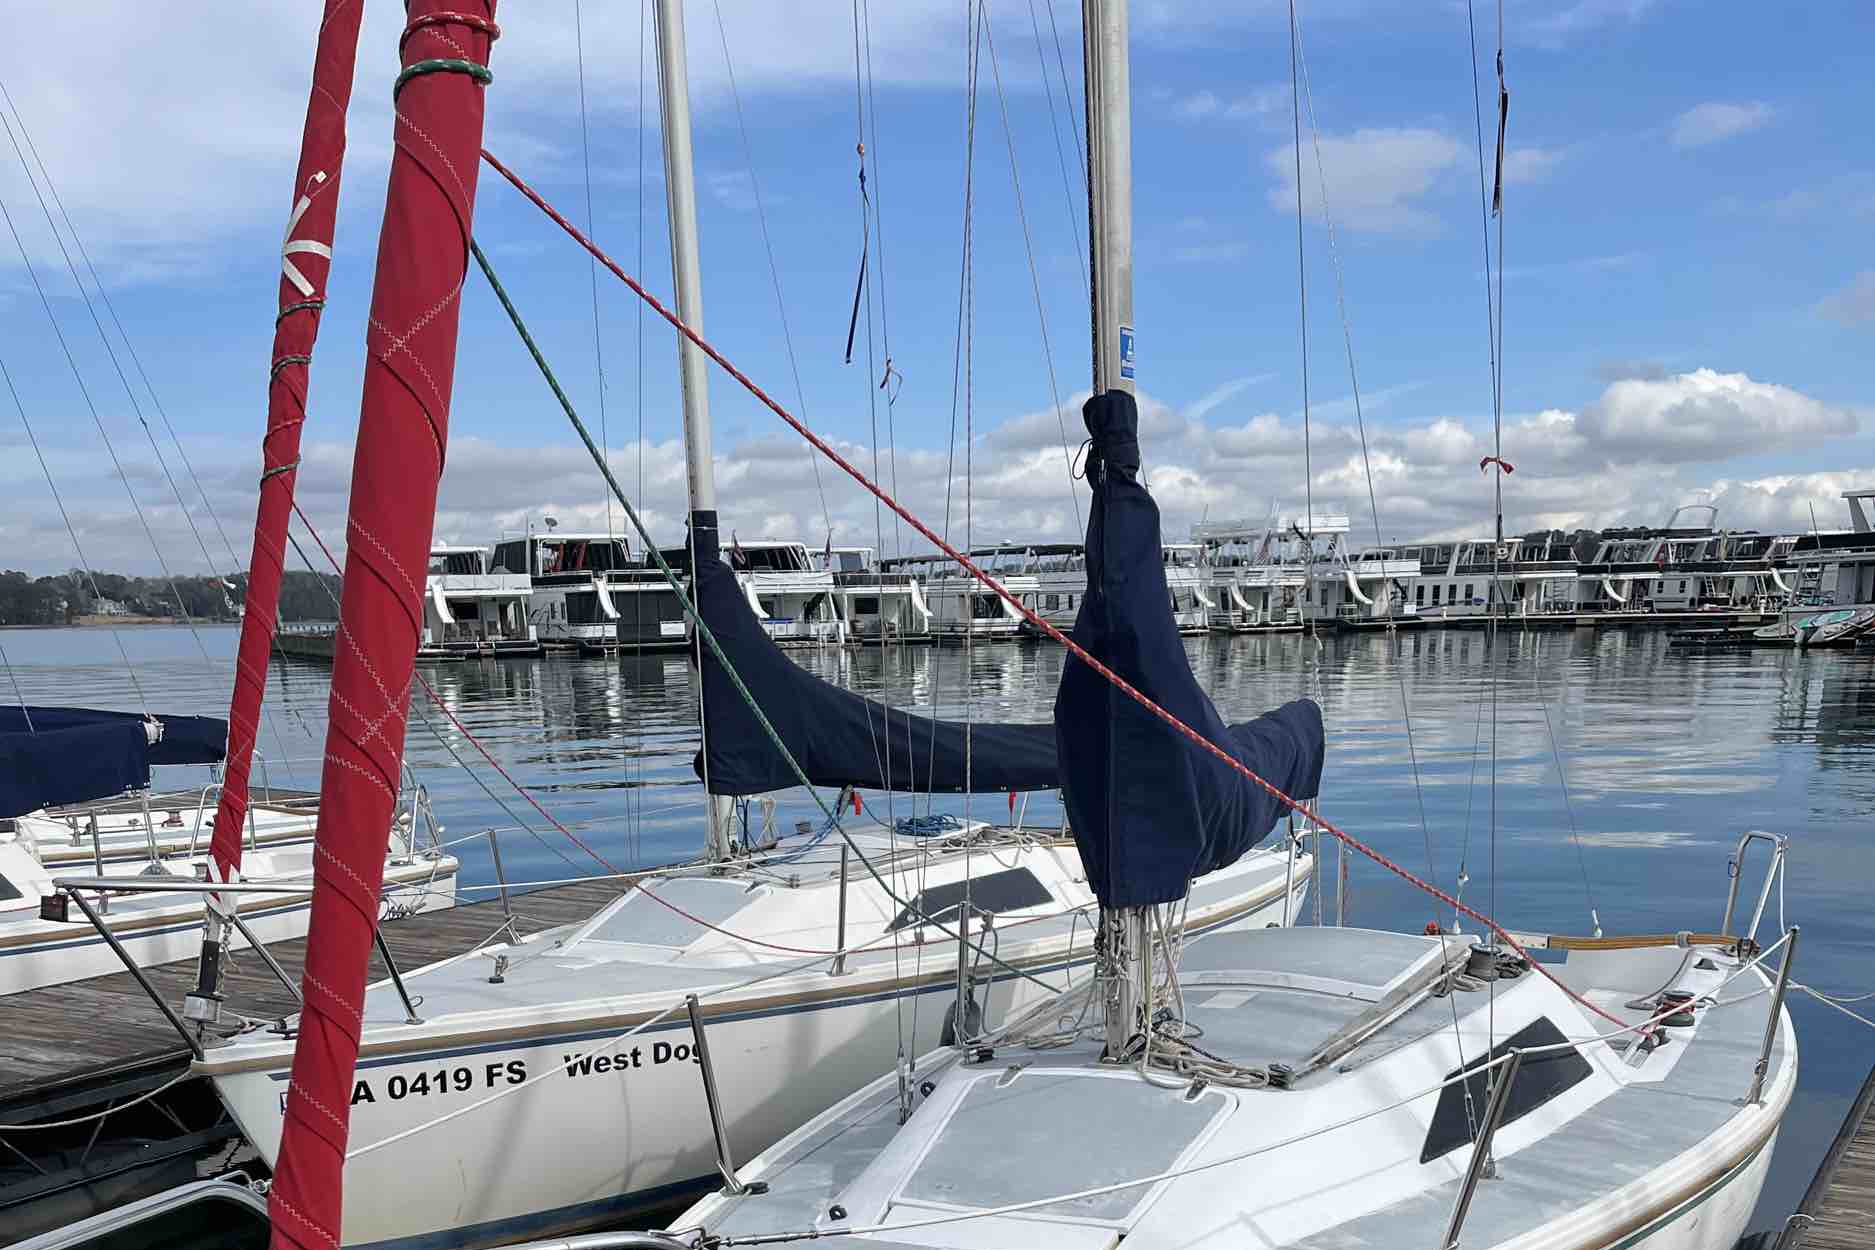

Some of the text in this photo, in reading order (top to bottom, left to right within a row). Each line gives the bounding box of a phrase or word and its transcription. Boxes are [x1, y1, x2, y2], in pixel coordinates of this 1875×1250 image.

[350, 1080, 376, 1105] A
[387, 1067, 472, 1100] 0419
[486, 1060, 527, 1088] FS
[564, 1046, 642, 1078] West
